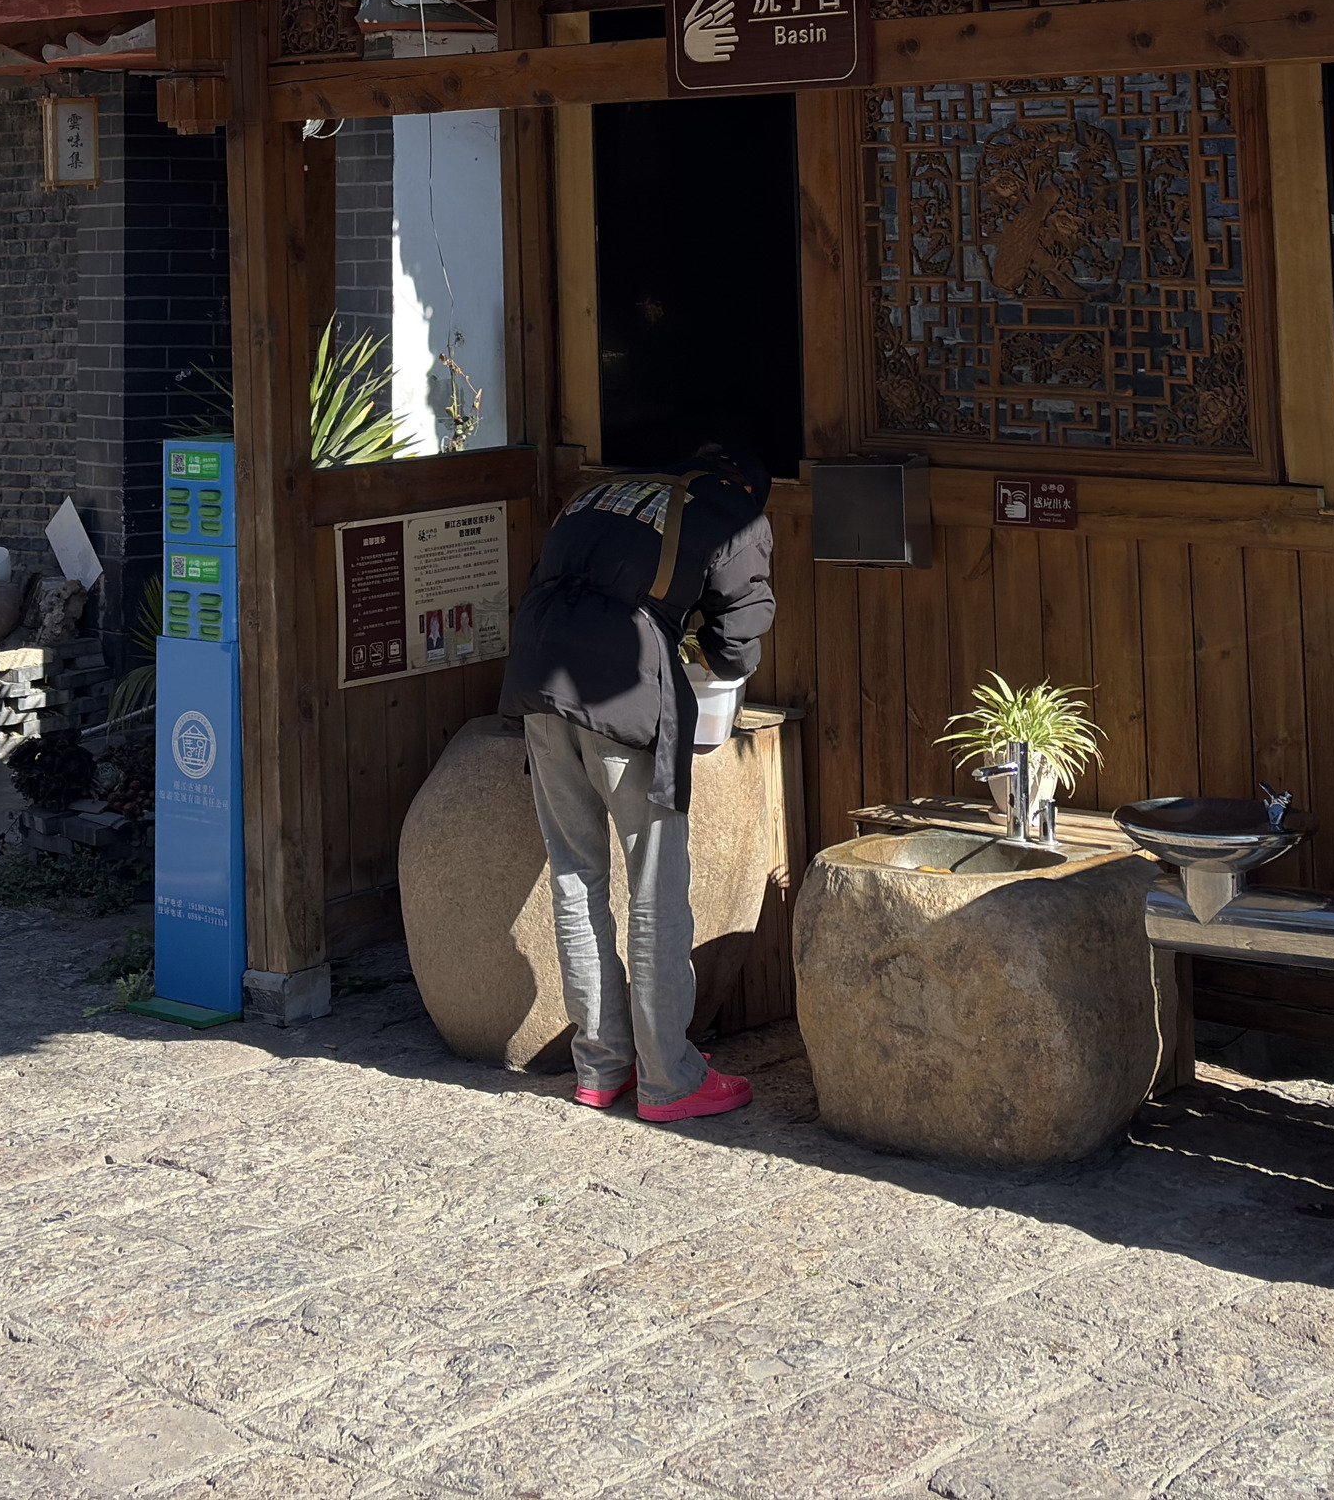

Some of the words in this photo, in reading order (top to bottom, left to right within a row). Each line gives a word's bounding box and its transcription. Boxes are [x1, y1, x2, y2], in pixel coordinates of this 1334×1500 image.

[774, 23, 827, 46] Basin
[67, 113, 83, 169] 雲味集
